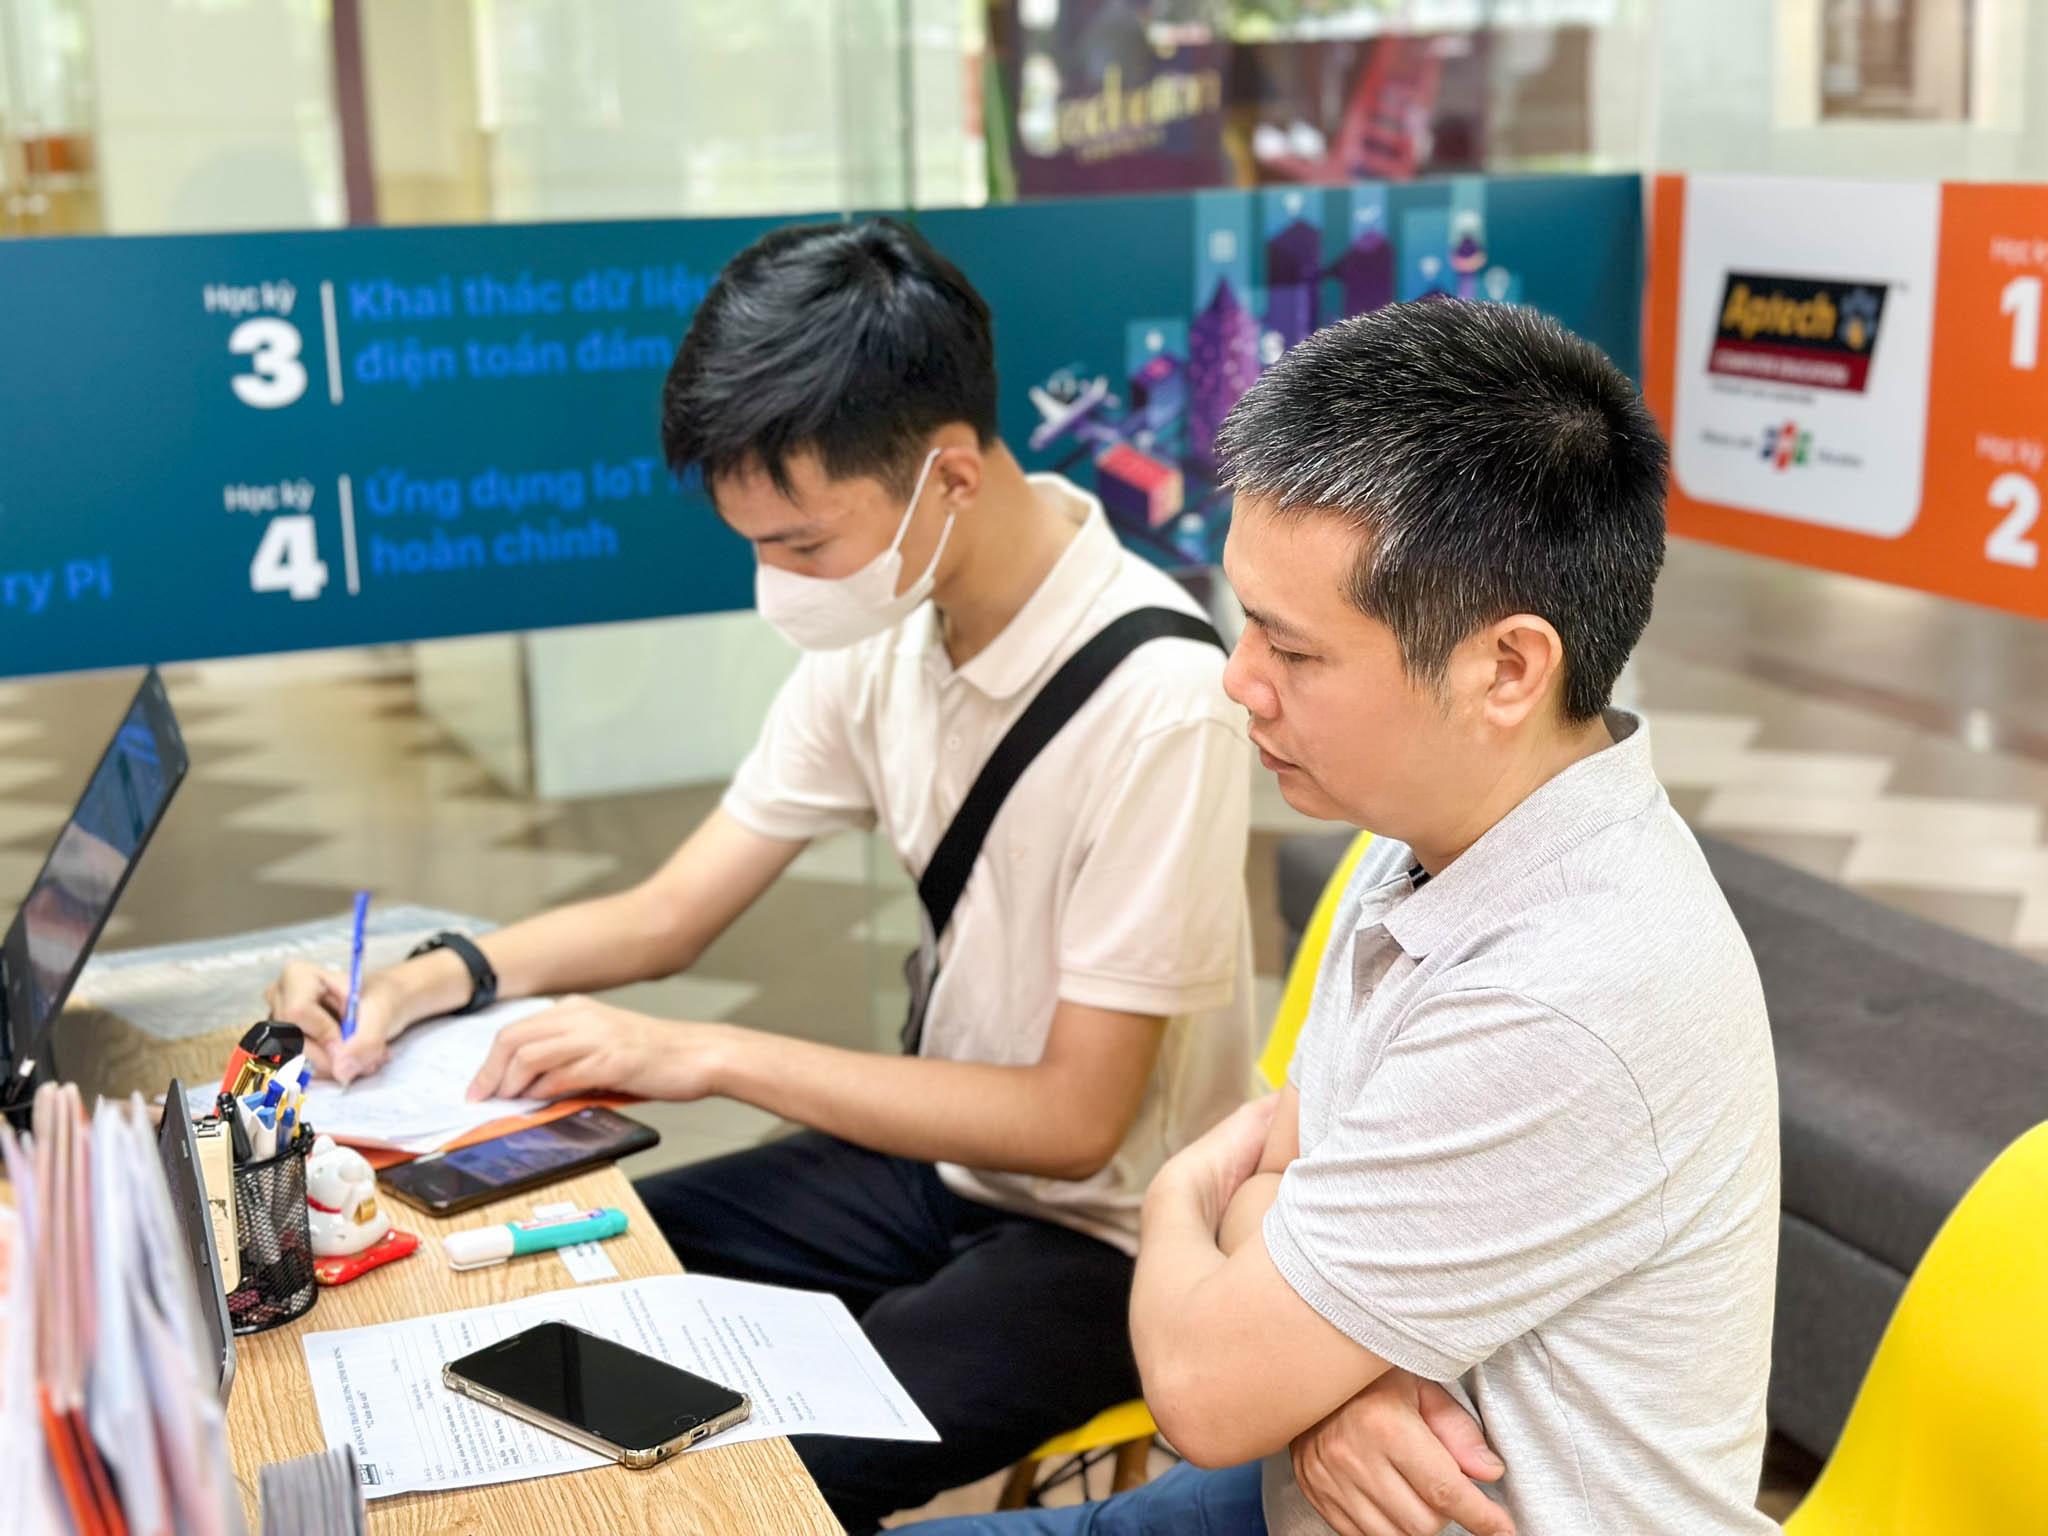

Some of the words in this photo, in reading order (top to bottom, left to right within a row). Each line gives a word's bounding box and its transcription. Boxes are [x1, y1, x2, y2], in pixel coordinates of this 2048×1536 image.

[349, 275, 452, 321] Khai
[464, 270, 563, 317] thác
[2001, 276, 2041, 370] 1
[229, 317, 308, 408] 3
[355, 337, 457, 391] điện
[465, 330, 567, 378] toán
[364, 464, 461, 521] Ứng
[469, 464, 584, 515] dụng
[592, 457, 656, 499] IoT
[1985, 471, 2040, 568] 2
[65, 555, 112, 600] Pi
[250, 515, 328, 601] 4
[371, 528, 485, 576] hoàn
